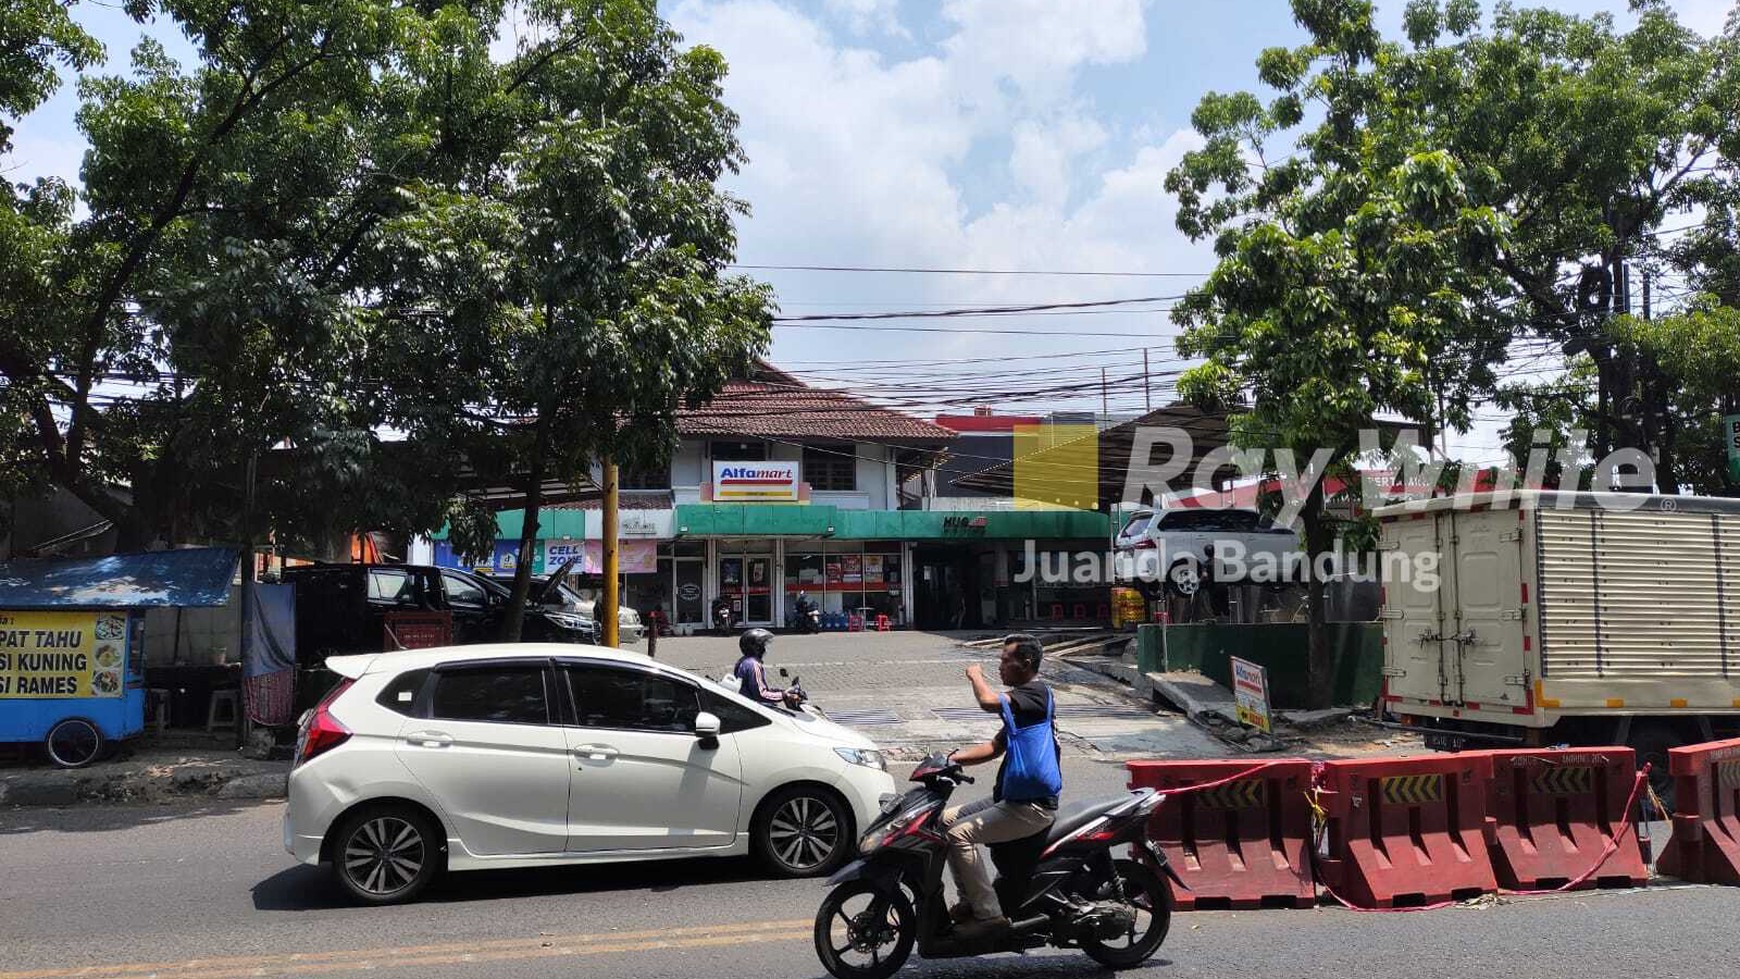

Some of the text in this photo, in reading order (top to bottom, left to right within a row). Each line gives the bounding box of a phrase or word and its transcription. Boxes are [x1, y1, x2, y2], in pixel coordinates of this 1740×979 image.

[721, 467, 793, 479] Alfamart
[549, 545, 578, 555] CELL
[35, 630, 82, 648] TAHU
[18, 653, 87, 671] KUNING
[17, 676, 78, 694] RAMES
